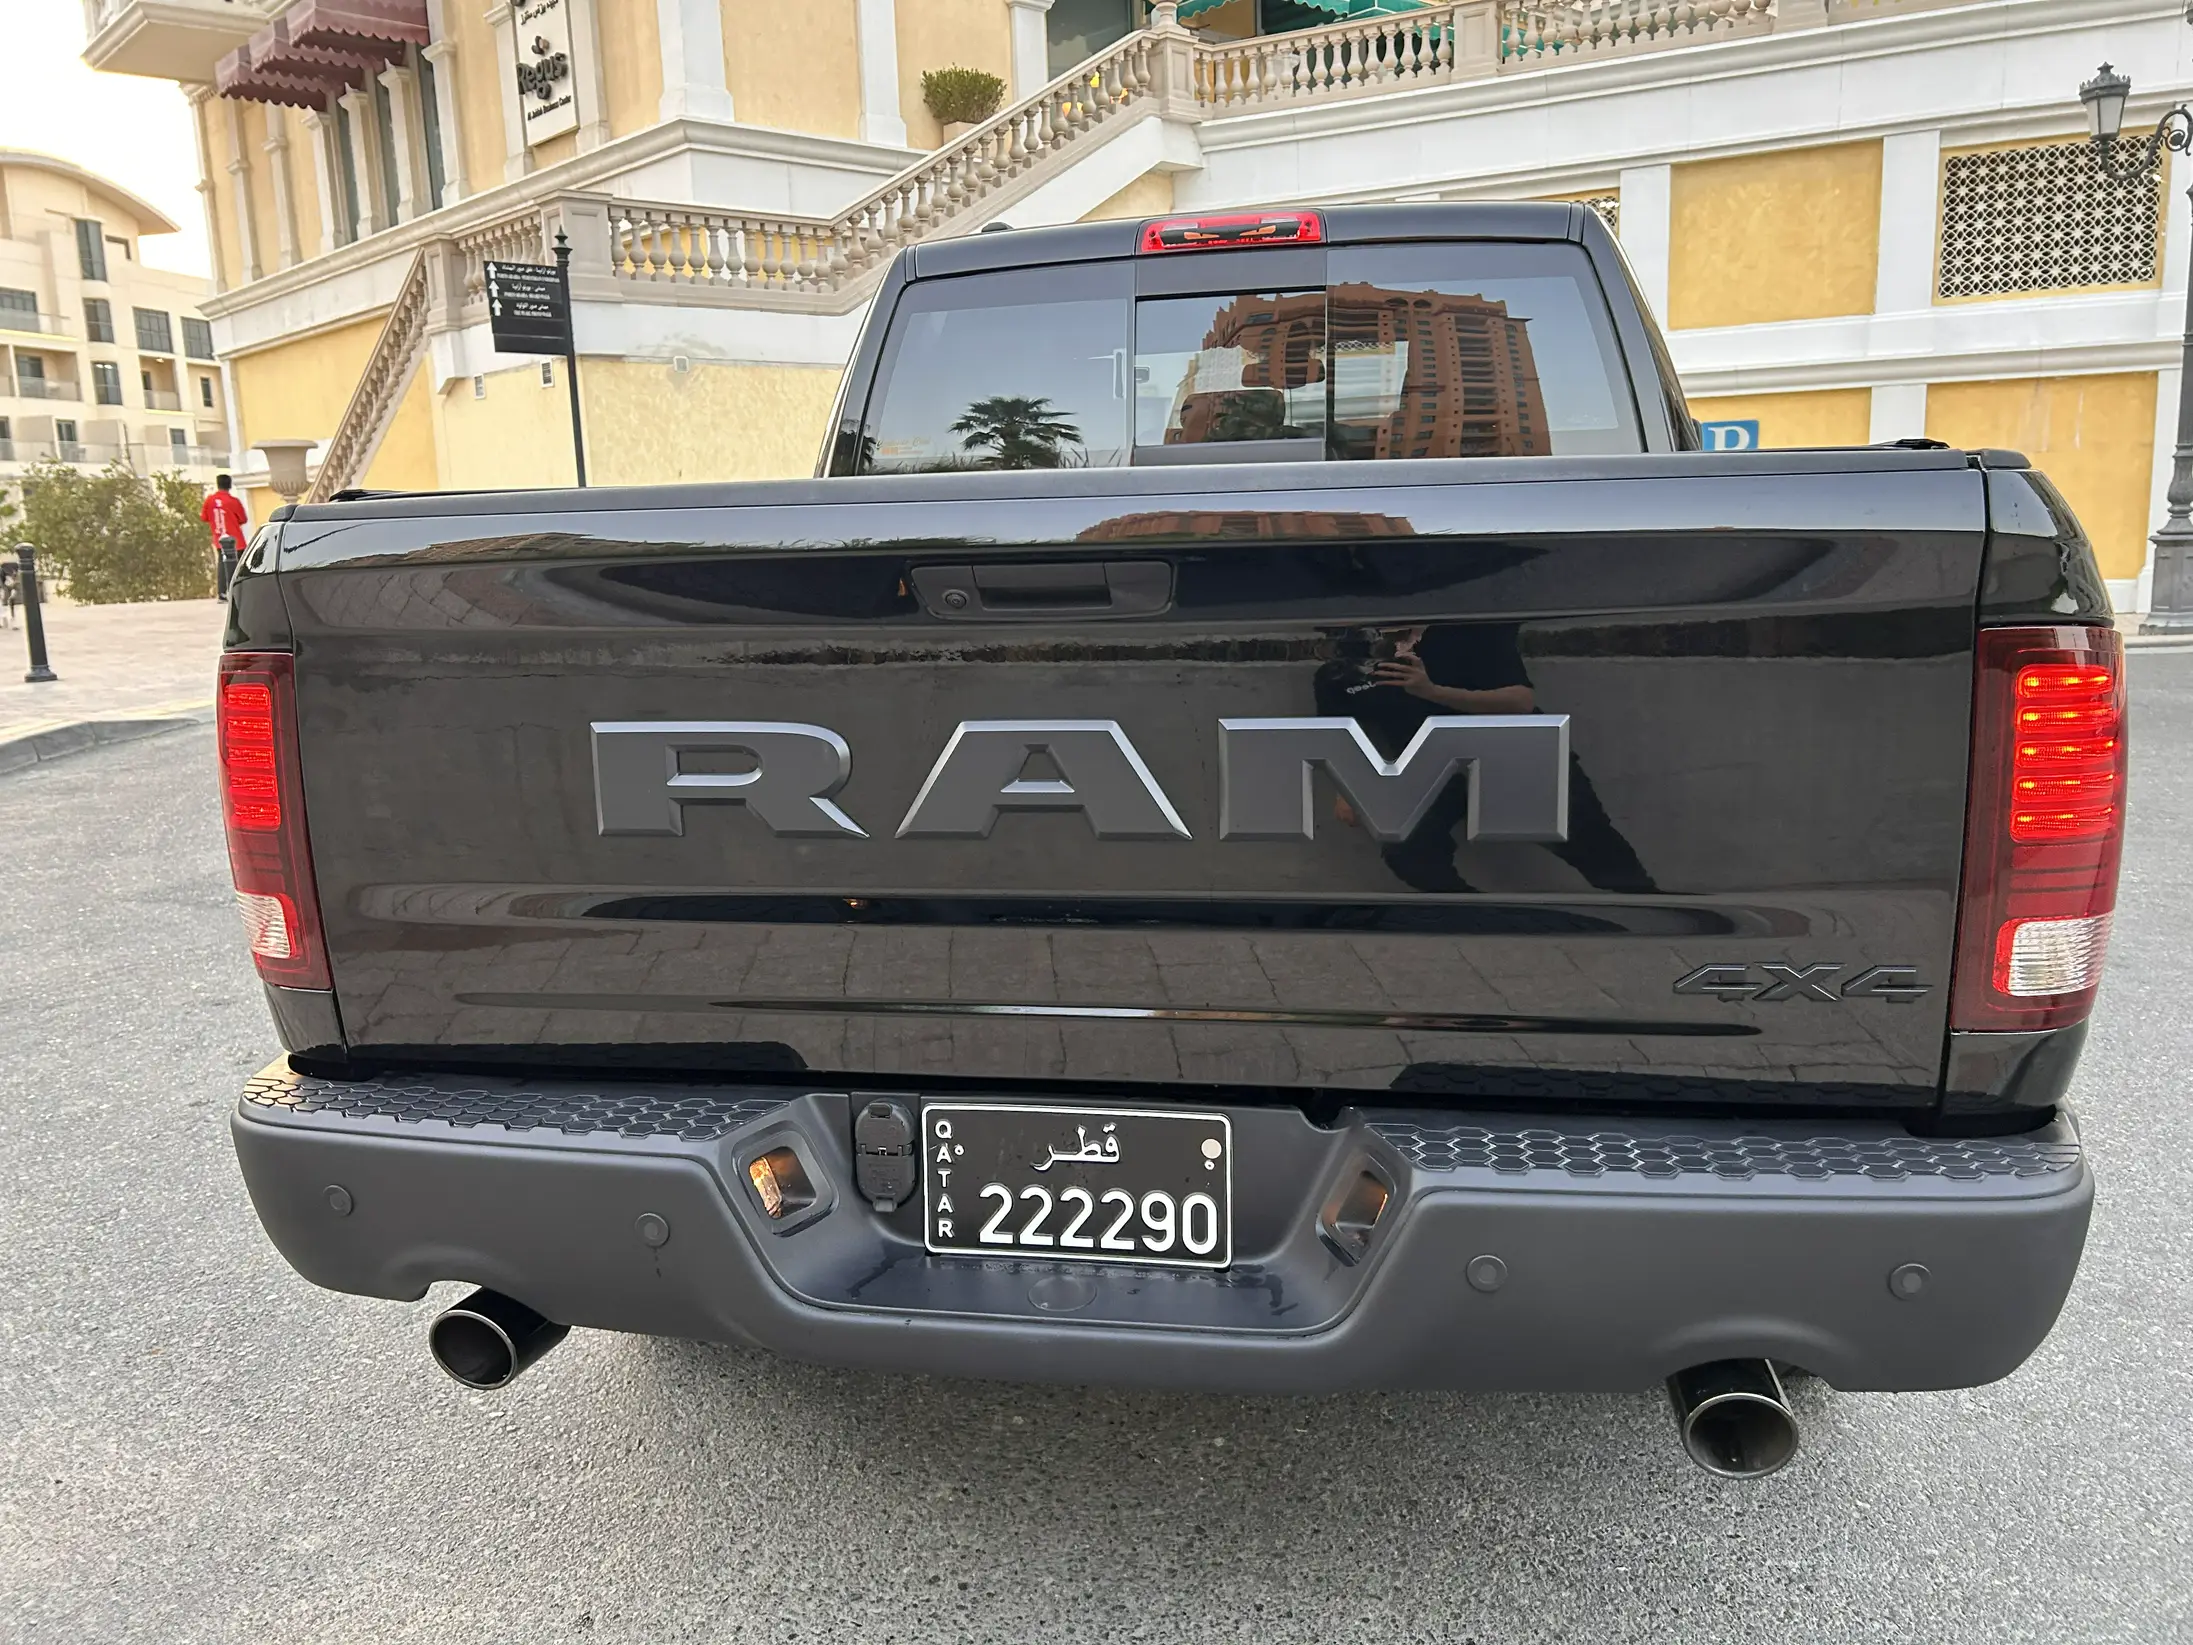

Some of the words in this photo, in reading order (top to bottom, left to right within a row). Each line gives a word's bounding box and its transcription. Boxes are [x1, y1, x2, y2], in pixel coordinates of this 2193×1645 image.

[516, 51, 569, 100] Regus
[589, 714, 1572, 842] RAM
[933, 1119, 956, 1240] QATAR
[1030, 1121, 1122, 1172] قطر
[977, 1182, 1219, 1256] 222290
